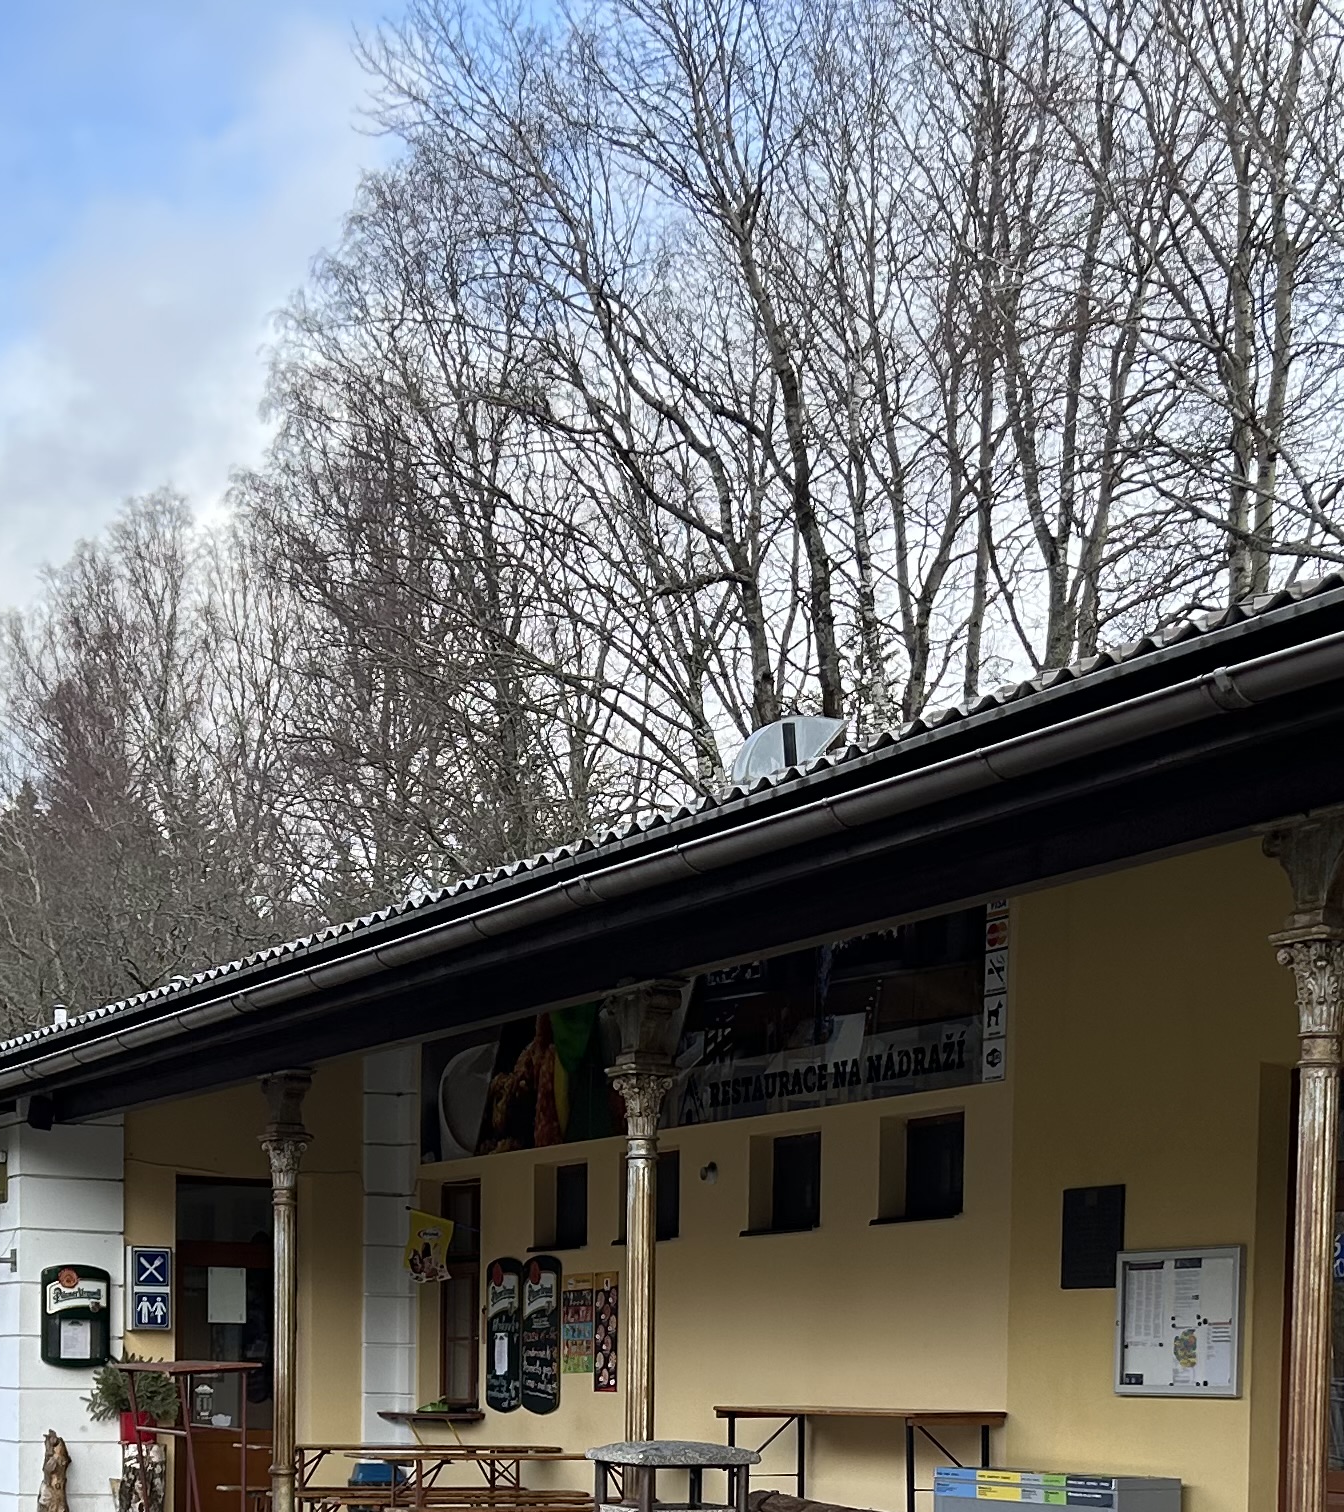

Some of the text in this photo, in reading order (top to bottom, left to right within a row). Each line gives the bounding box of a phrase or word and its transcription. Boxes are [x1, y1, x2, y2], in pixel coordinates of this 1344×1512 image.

[709, 1031, 966, 1108] RESTAURACE NA NÁDRAŽÍ
